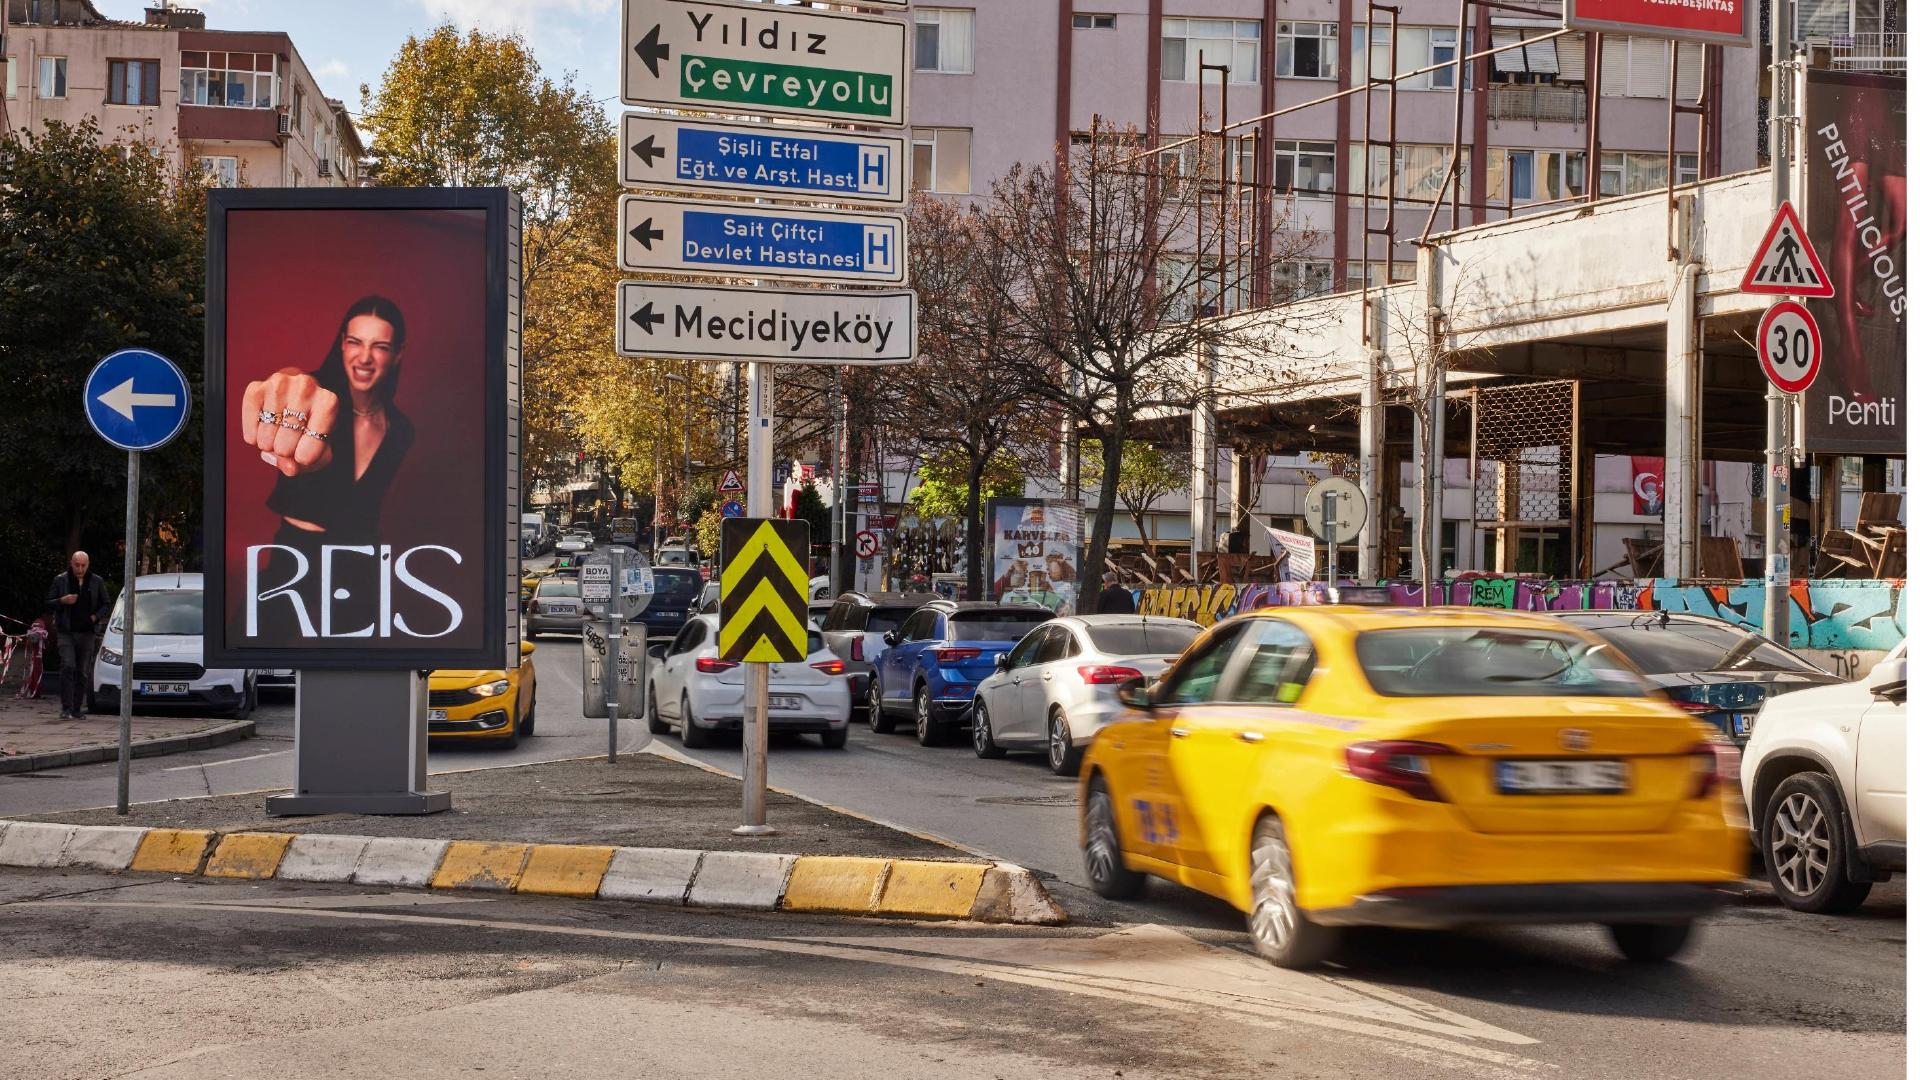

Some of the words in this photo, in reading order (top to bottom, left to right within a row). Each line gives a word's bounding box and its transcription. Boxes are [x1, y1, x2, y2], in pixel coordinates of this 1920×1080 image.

[686, 11, 827, 55] Yıldız
[684, 58, 889, 107] Çevreyolu
[718, 137, 762, 157] Şişli
[770, 141, 819, 161] Etfal
[680, 157, 719, 180] Eğt.
[724, 166, 748, 178] ve
[754, 163, 801, 184] Arşt.
[807, 169, 858, 189] Hast.
[862, 152, 885, 187] H
[723, 219, 764, 238] Sait
[771, 222, 824, 244] Çiftçi
[685, 240, 753, 261] Devlet
[760, 246, 860, 268] Hastanesi
[868, 232, 889, 266] H
[674, 304, 894, 353] Mecidiyeköy
[1771, 324, 1810, 369] 30
[1828, 395, 1896, 426] Penti
[585, 567, 609, 575] BOYA
